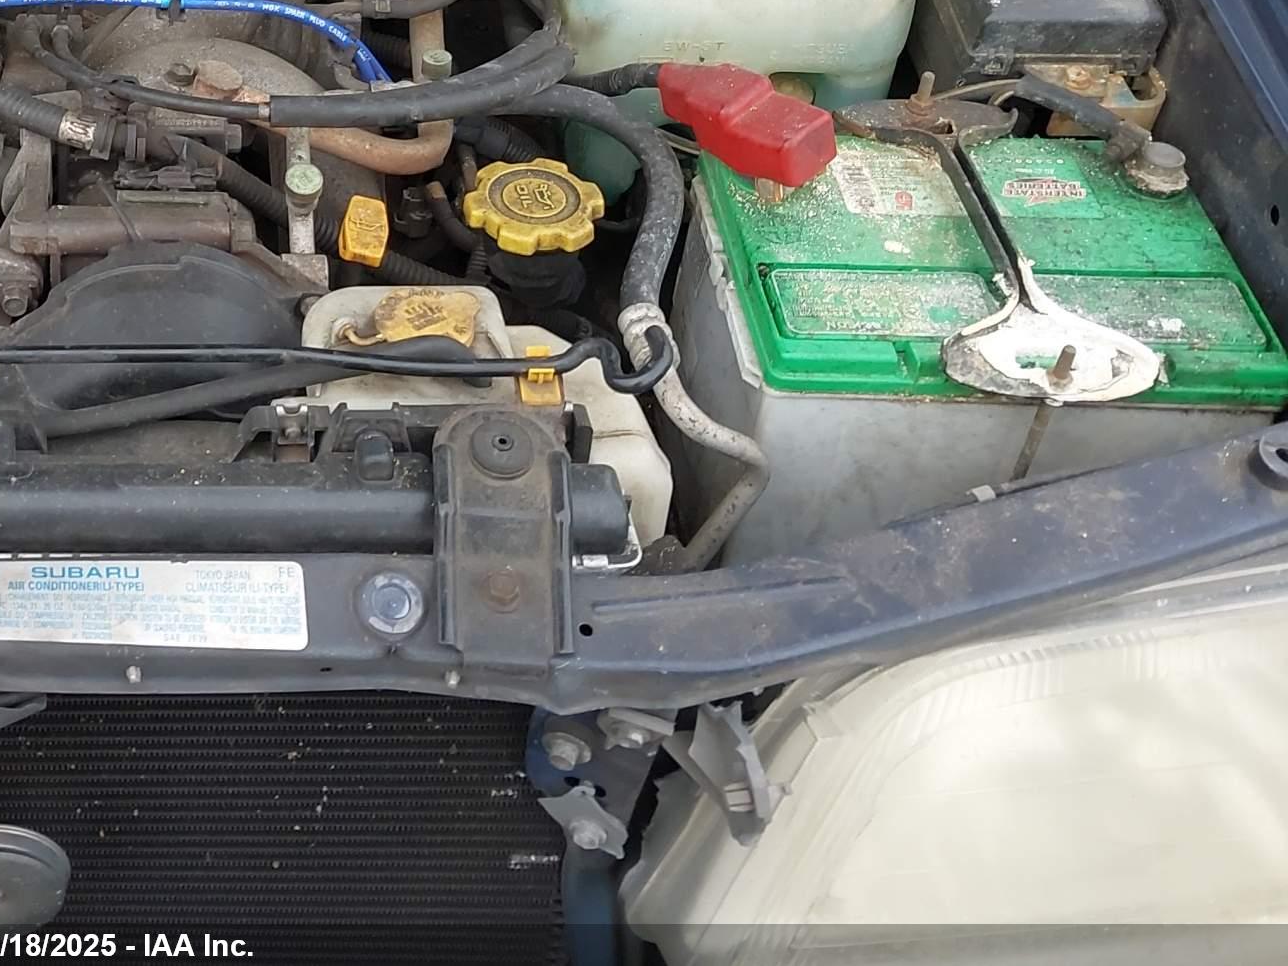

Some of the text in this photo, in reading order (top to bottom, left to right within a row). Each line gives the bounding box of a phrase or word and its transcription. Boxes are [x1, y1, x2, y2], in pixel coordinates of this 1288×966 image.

[516, 184, 532, 208] OIL
[31, 567, 140, 579] SUBARU
[195, 569, 250, 580] TOKYO JAPAN
[8, 581, 25, 590] AIR
